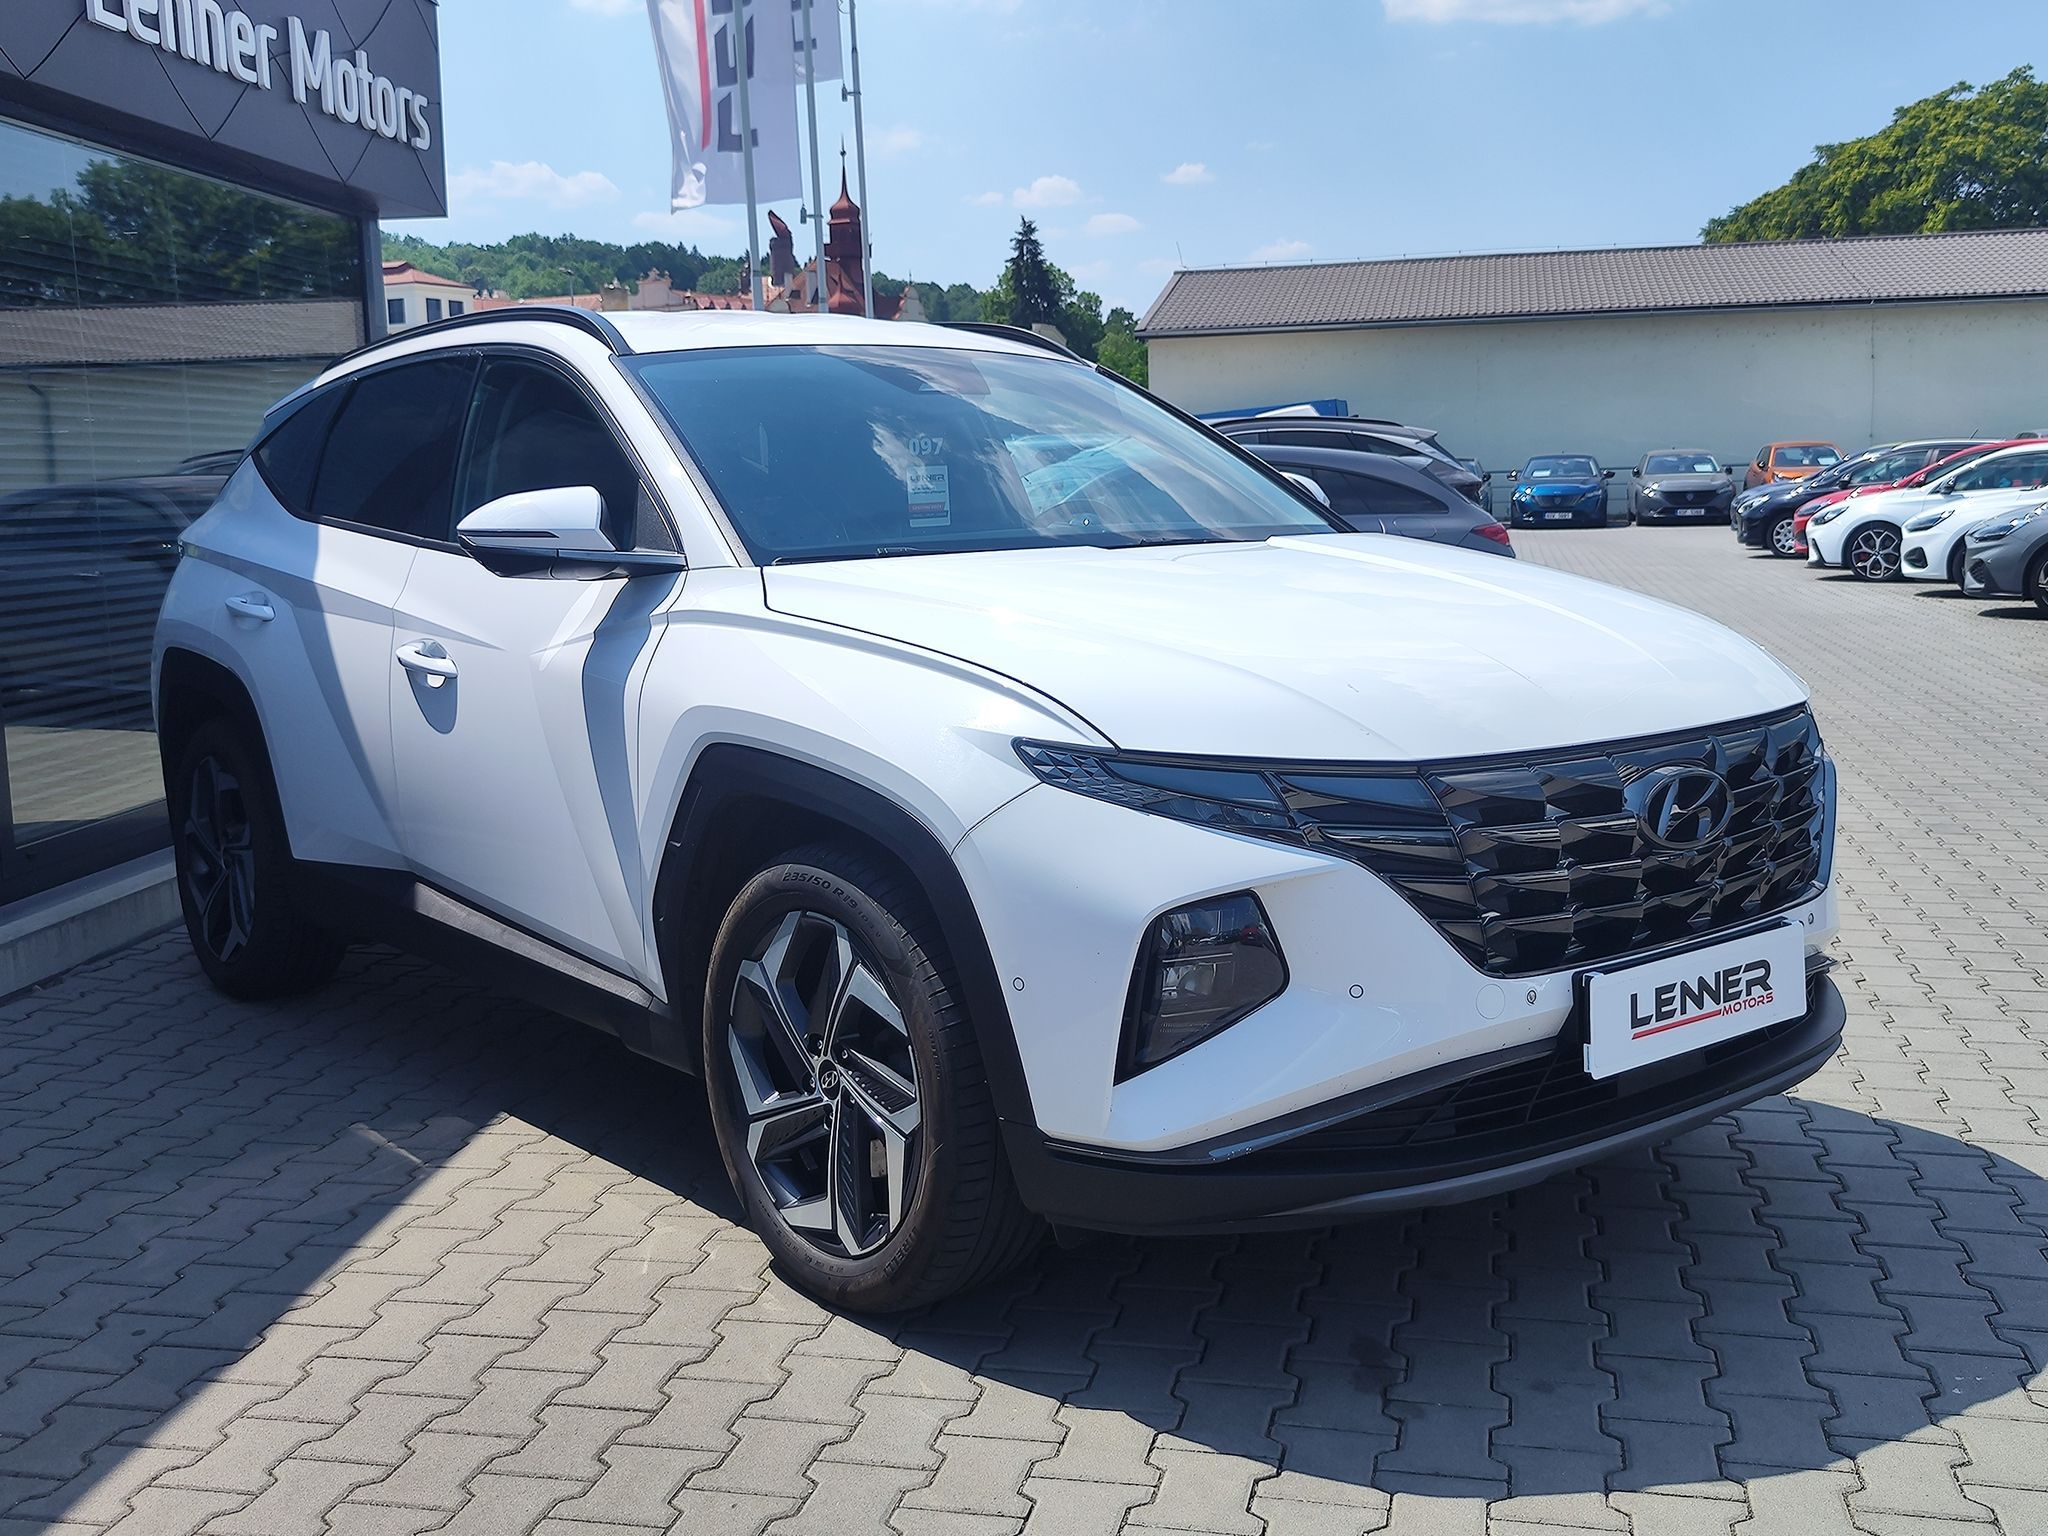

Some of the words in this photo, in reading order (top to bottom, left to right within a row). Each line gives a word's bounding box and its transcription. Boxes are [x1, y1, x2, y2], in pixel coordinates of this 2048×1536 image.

[287, 15, 432, 151] Motors
[908, 437, 944, 456] 097
[782, 872, 832, 889] 235/50
[832, 887, 858, 909] R19
[1630, 959, 1773, 1030] LENNER
[1721, 992, 1774, 1017] MOTORS
